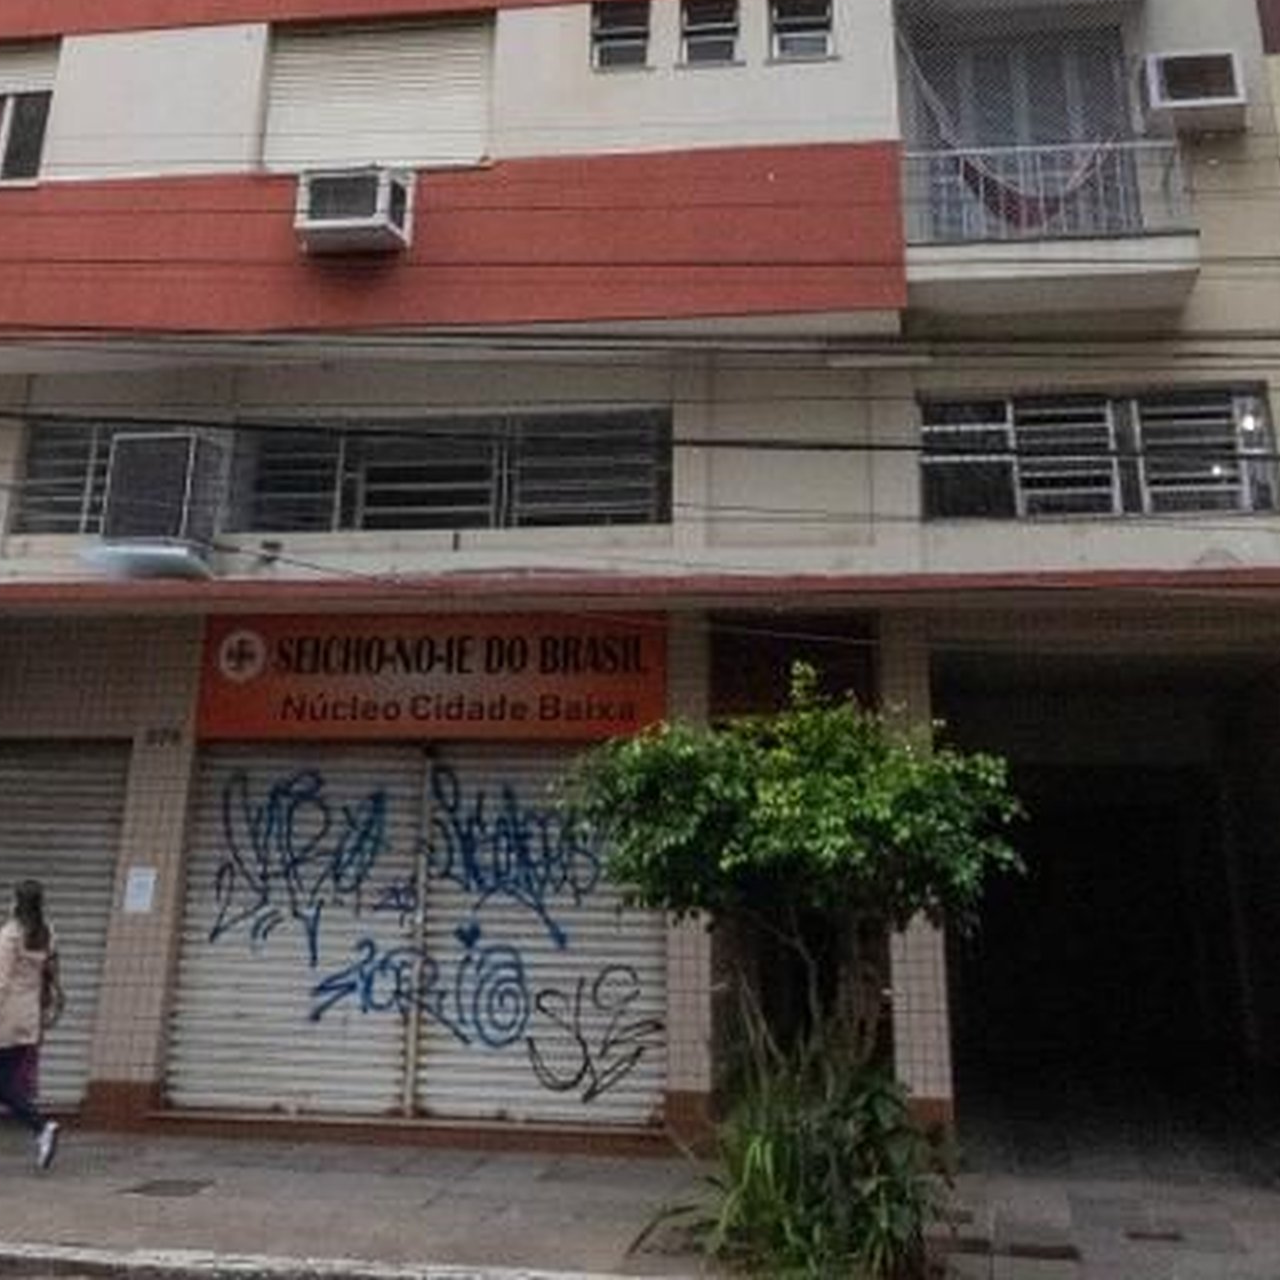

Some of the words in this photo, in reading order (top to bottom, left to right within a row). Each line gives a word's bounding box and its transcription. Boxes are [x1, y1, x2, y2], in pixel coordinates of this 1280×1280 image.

[275, 634, 474, 674] SEICHO-NO-IE
[485, 634, 529, 673] DO
[539, 634, 645, 675] BRASIL
[281, 692, 402, 721] Núcleo
[410, 692, 528, 721] Cidade
[538, 693, 636, 721] Baixa
